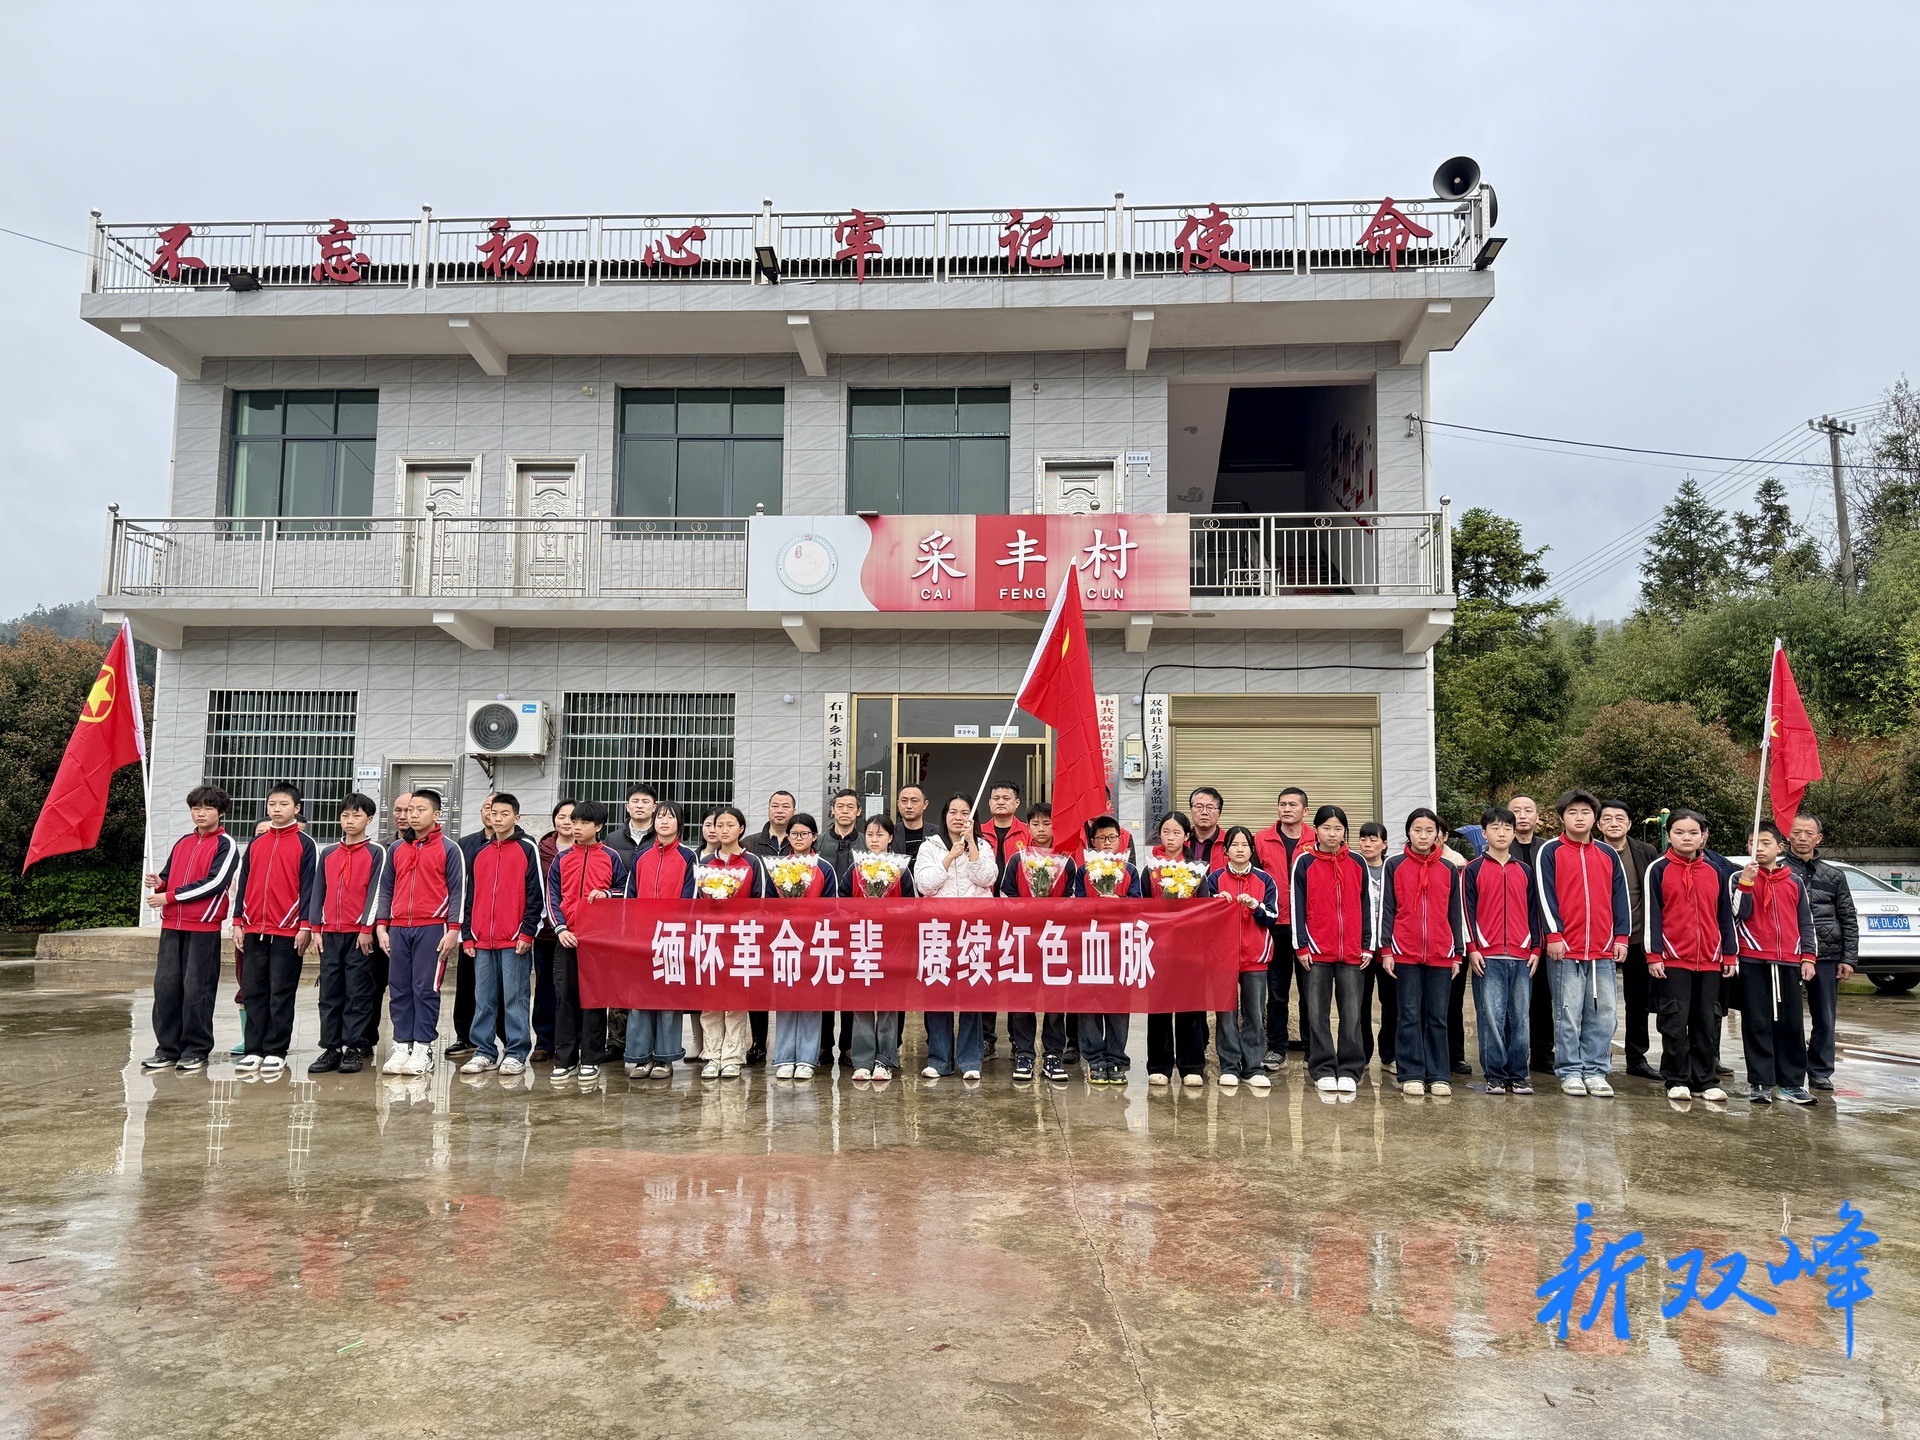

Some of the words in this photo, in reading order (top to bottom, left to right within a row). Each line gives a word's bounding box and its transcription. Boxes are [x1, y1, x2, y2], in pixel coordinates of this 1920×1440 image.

[151, 198, 1431, 282] 不忘初心牢记使命
[912, 529, 1138, 583] 采丰村
[921, 588, 951, 600] CAI
[1000, 587, 1046, 599] FENG
[1087, 587, 1124, 599] CUN
[827, 701, 844, 831] 石牛乡采丰村村民
[651, 918, 884, 988] 缅怀革命先辈
[916, 918, 1156, 989] 赓续红色血脉
